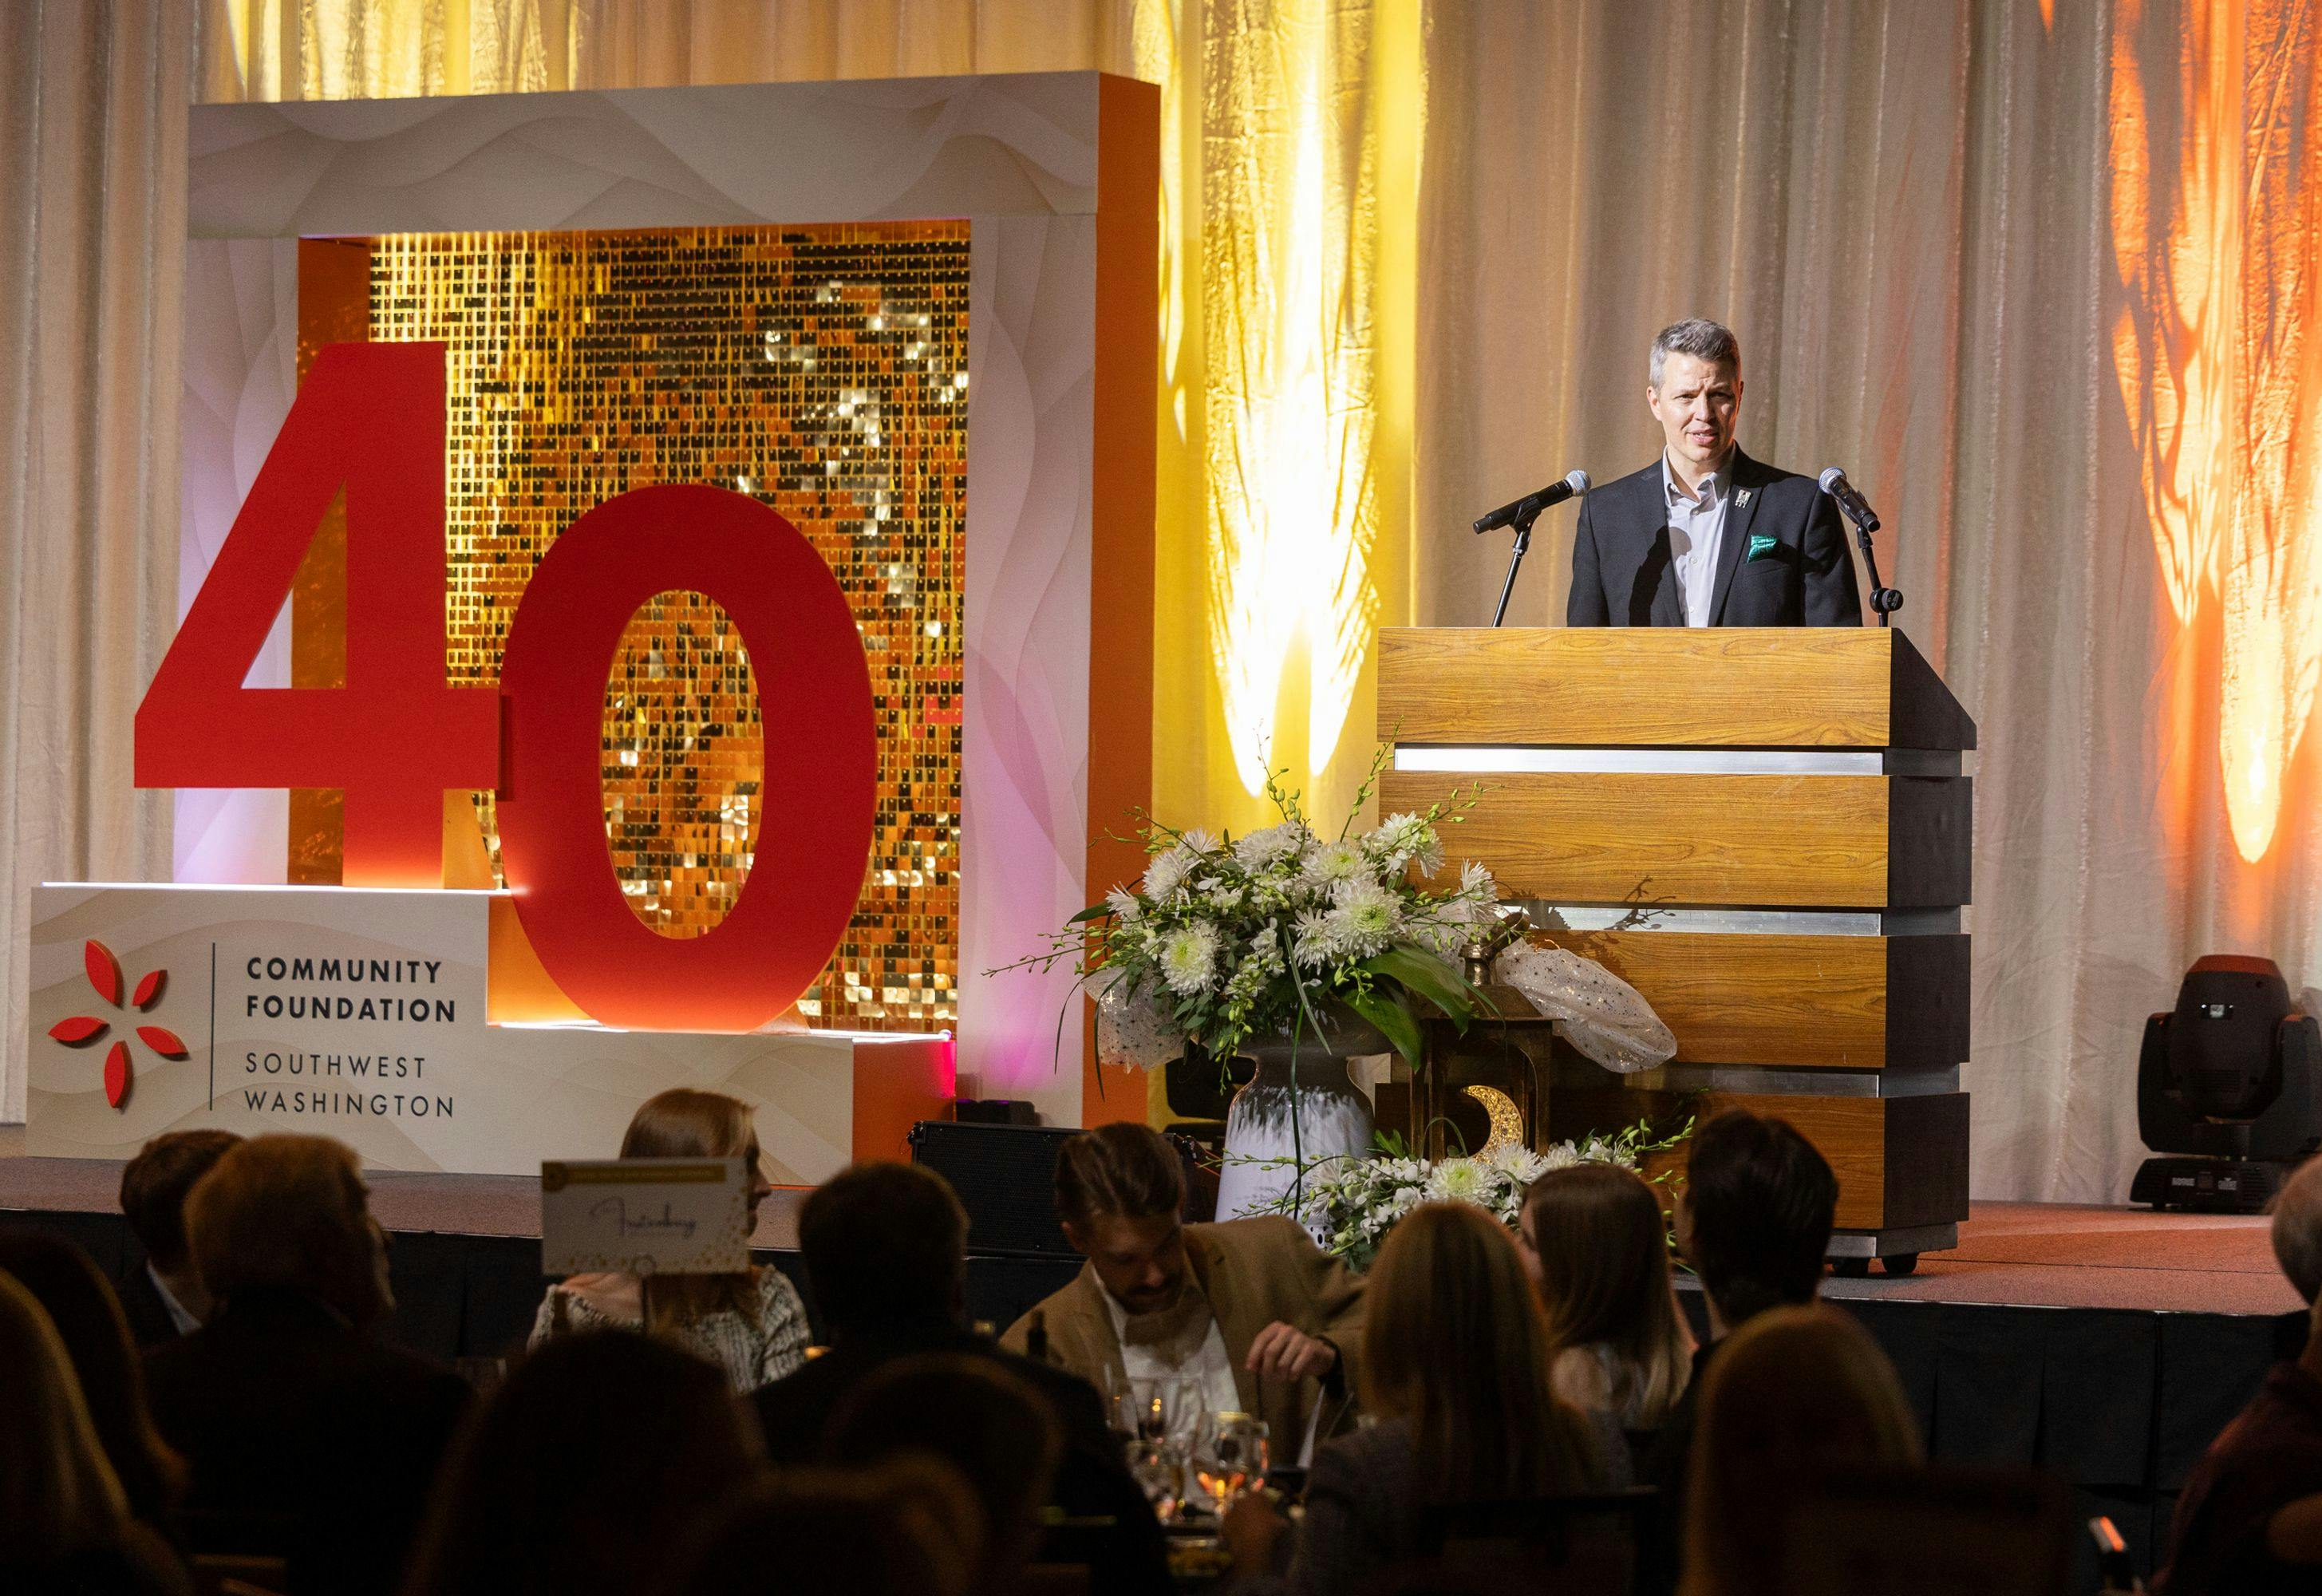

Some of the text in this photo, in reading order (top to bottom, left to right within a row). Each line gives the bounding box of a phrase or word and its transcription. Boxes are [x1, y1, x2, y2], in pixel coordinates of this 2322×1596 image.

[134, 341, 878, 1033] 40
[246, 956, 442, 984] COMMUNITY
[247, 994, 455, 1023] FOUNDATION
[245, 1052, 425, 1078] SOUTHWEST
[243, 1090, 453, 1117] WASHINGTON
